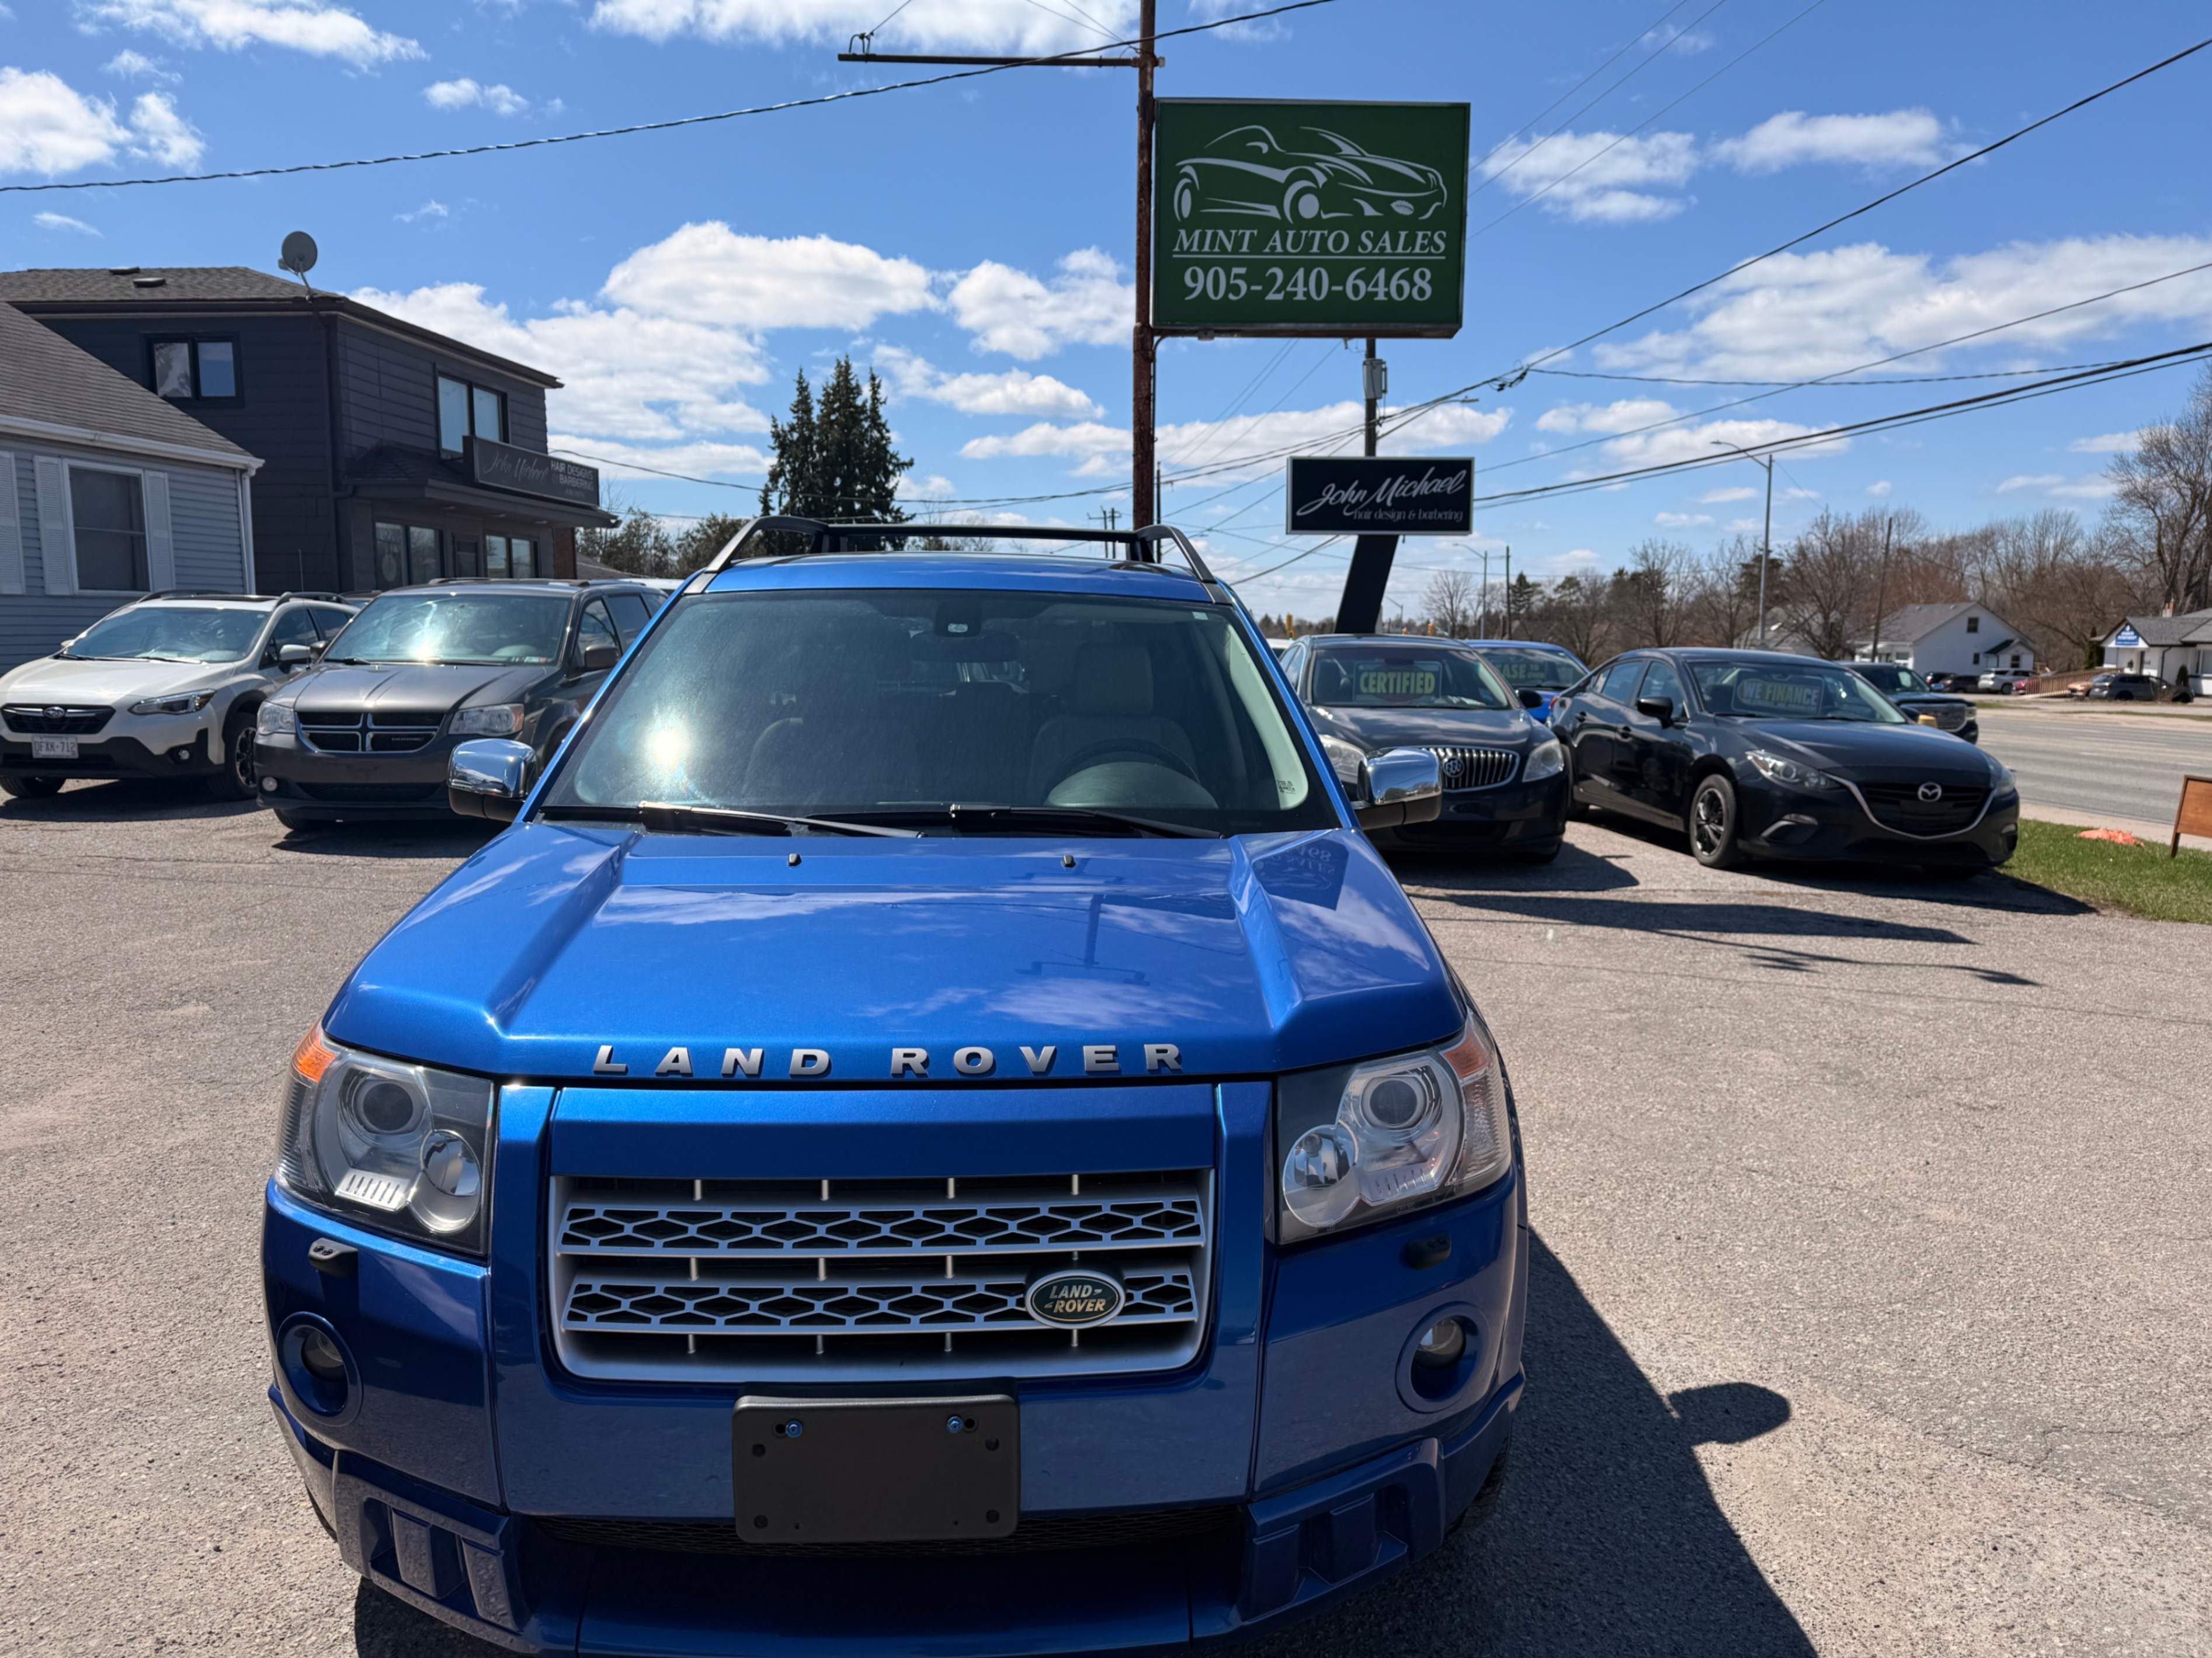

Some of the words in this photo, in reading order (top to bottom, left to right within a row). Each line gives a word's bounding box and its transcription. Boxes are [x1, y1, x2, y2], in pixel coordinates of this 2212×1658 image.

[1172, 228, 1258, 253] MINT
[1263, 229, 1350, 254] AUTO
[1357, 230, 1446, 254] SALES
[1183, 266, 1433, 301] 905-240-6468
[551, 460, 566, 473] HAIR
[1296, 479, 1368, 516] John
[1343, 466, 1467, 516] Michael
[1353, 508, 1373, 520] hair
[1374, 508, 1406, 522] design
[1408, 509, 1416, 520] &
[1418, 508, 1463, 522] barbering
[1360, 672, 1435, 693] CERTIFIED
[1744, 681, 1762, 699] WE
[1765, 684, 1818, 706] FINANCE
[593, 1045, 831, 1078] LAND
[891, 1043, 1183, 1076] ROVER
[1049, 1285, 1092, 1299] LAND
[1053, 1299, 1106, 1313] ROVER
